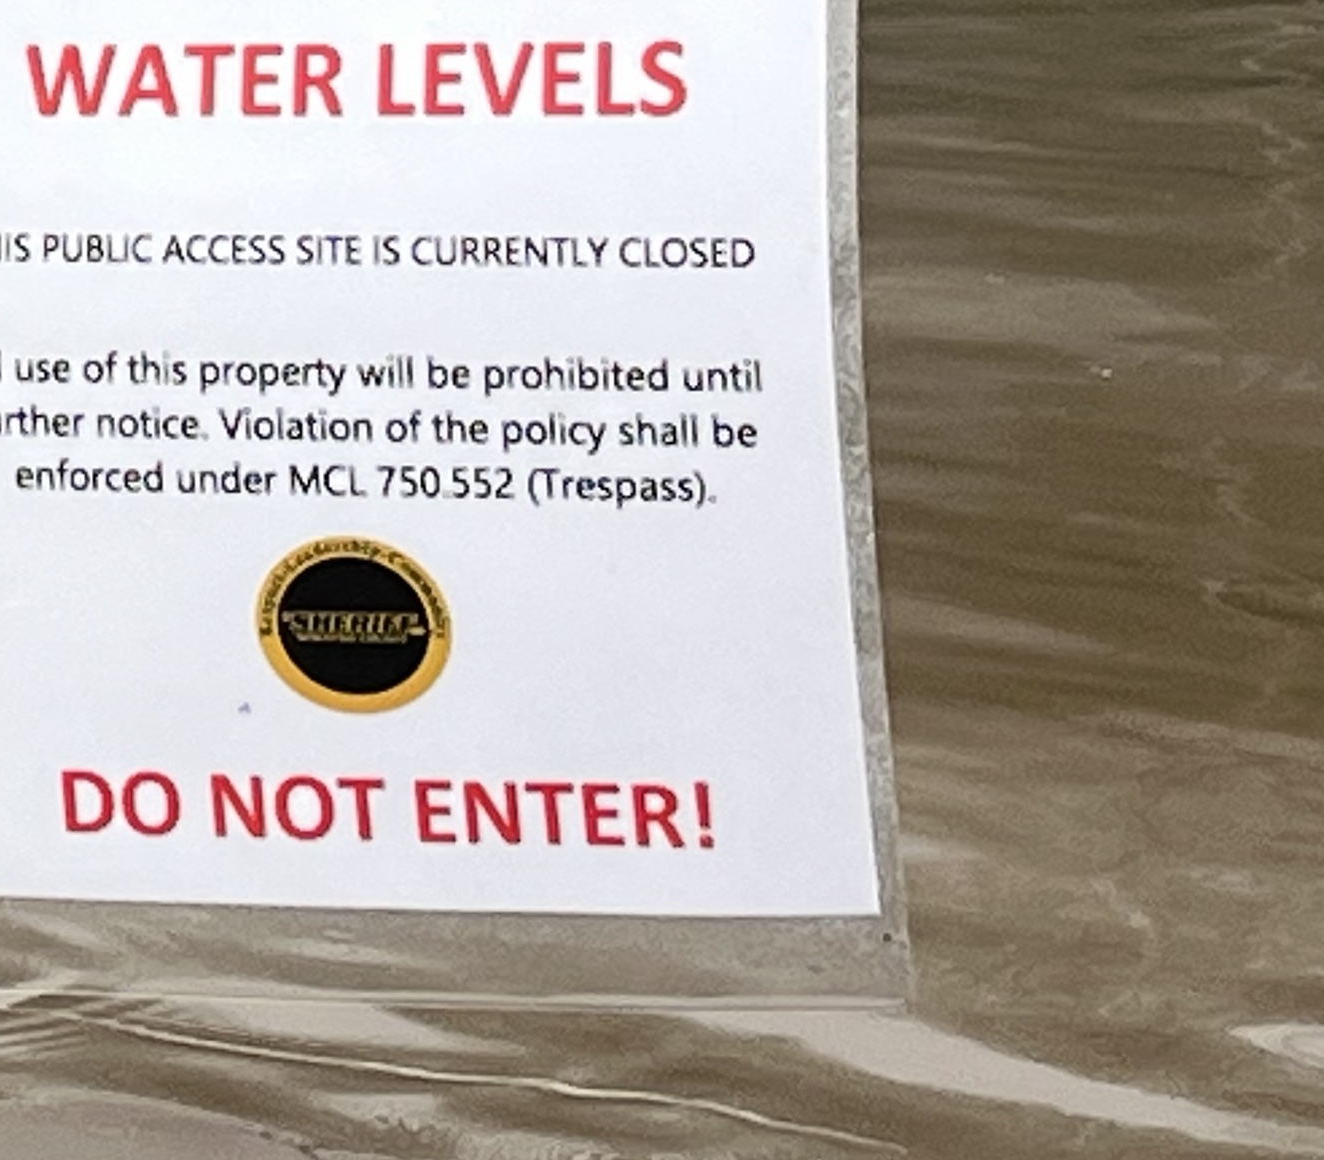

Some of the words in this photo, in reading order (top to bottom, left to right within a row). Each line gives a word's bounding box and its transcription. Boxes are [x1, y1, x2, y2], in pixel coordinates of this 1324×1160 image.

[25, 43, 343, 118] WATER
[377, 39, 688, 118] LEVELS
[42, 233, 152, 264] PUBLIC
[161, 233, 286, 266] ACCESS
[295, 234, 361, 267] SITE
[373, 234, 401, 267] IS
[410, 235, 609, 268] CURRENTLY
[618, 236, 756, 269] CLOSED
[14, 357, 72, 386] use
[82, 349, 119, 385] of
[126, 352, 189, 387] this
[198, 357, 349, 397] property
[356, 355, 415, 389] will
[426, 358, 471, 391] be
[483, 356, 670, 398] prohibited
[682, 359, 763, 393] until
[95, 407, 209, 442] notice.
[218, 406, 374, 443] Violation
[384, 408, 423, 444] of
[430, 412, 490, 446] the
[500, 412, 608, 457] policy
[617, 414, 700, 448] shall
[710, 414, 759, 450] be
[14, 456, 165, 494] enforced
[176, 461, 278, 496] under
[288, 463, 366, 498] MCL
[376, 464, 515, 501] 750.552
[525, 466, 717, 510] (Trespass).
[60, 769, 182, 837] DO
[209, 773, 387, 842] NOT
[413, 778, 716, 850] ENTER!
